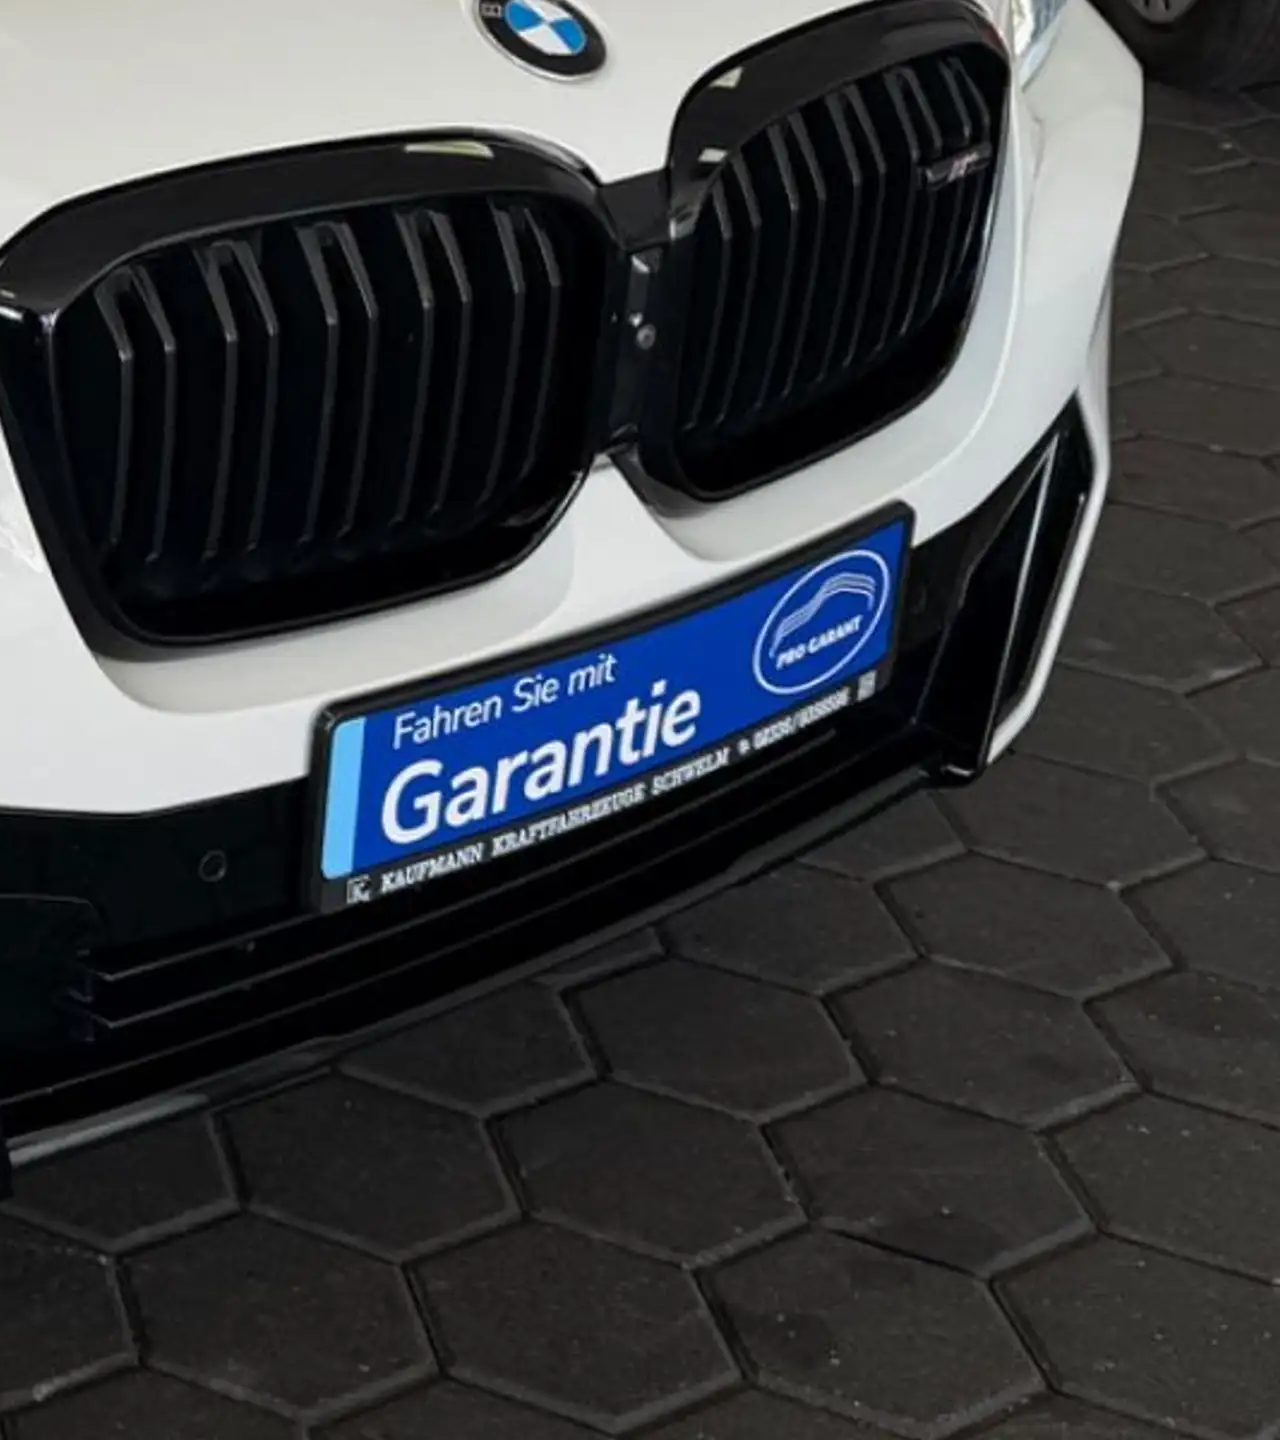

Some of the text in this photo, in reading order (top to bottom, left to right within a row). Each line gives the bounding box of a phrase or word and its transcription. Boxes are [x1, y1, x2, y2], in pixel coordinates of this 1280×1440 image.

[381, 679, 701, 844] Garantie
[393, 653, 617, 750] Fahren Sie mit
[379, 841, 484, 894] KAUFMANN
[491, 782, 647, 857] KRAFTFAHRZEUGE
[651, 746, 731, 796] SCHWELM
